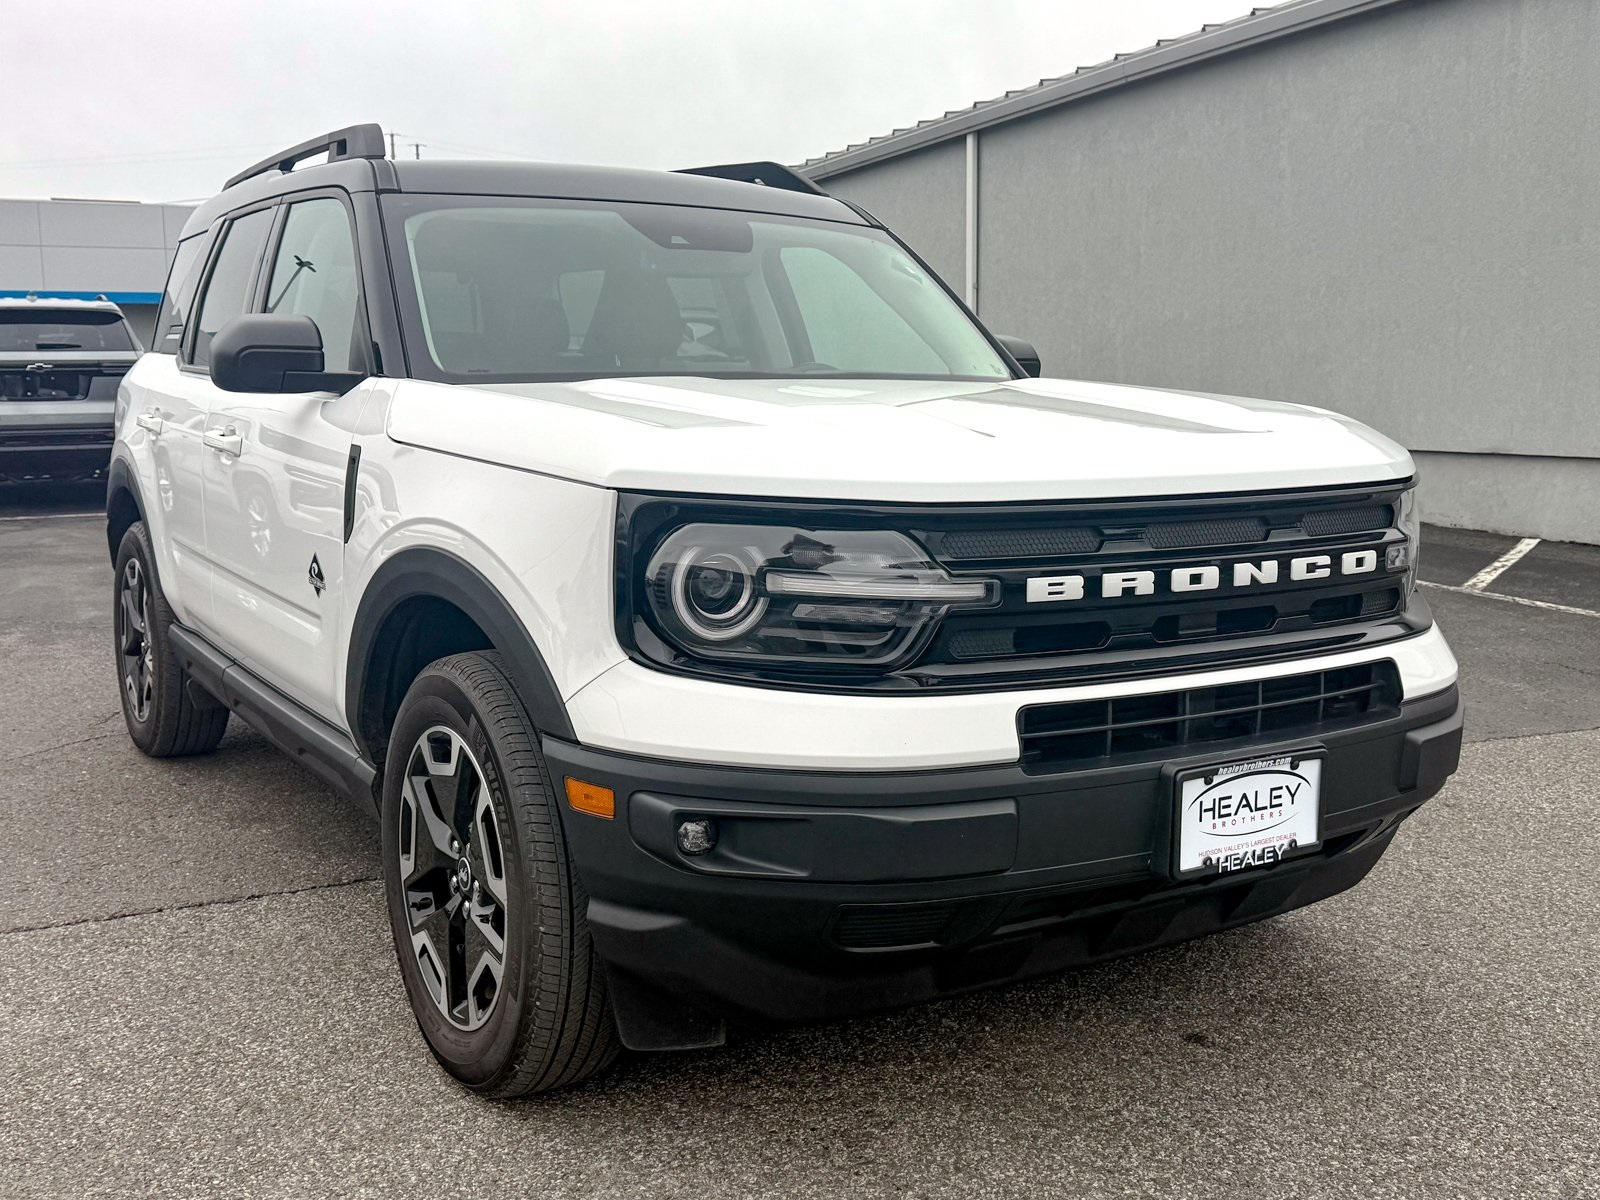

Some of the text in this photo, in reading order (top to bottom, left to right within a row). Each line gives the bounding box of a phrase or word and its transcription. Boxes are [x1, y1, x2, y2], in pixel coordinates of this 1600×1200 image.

[1026, 550, 1377, 603] BRONCO
[1218, 757, 1292, 775] healeybrothers.com
[1199, 783, 1301, 823] HEALEY
[1212, 810, 1283, 830] BROTHERS
[1198, 832, 1297, 858] HUDSON VALLEY'S LARGEST DEALER
[1218, 845, 1285, 873] HEALEY
